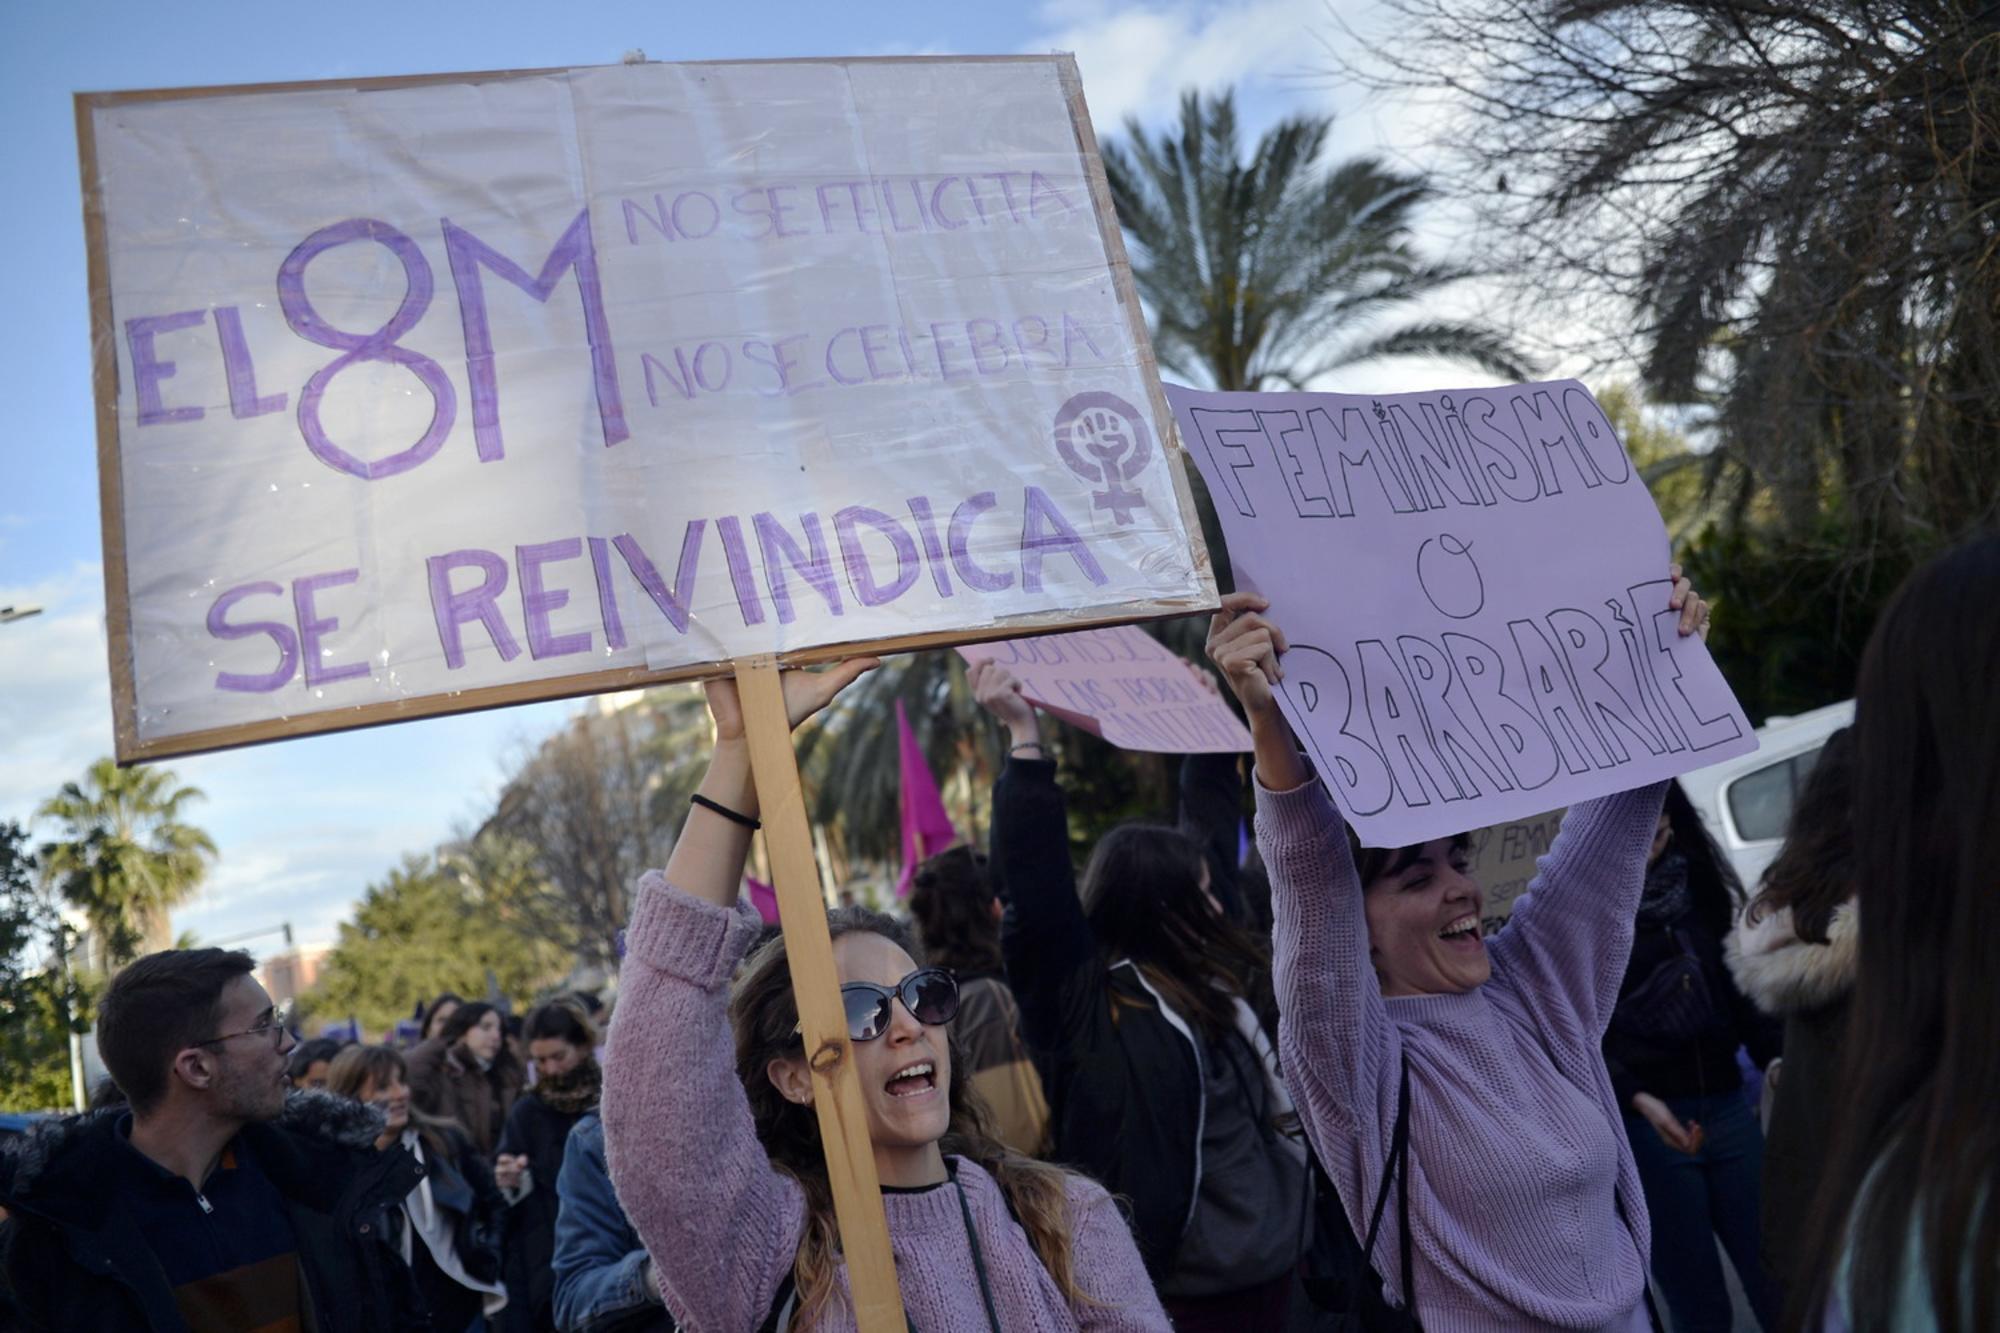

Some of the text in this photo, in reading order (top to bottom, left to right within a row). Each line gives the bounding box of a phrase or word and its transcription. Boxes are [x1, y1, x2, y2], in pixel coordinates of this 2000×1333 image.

[621, 170, 1079, 245] NO SE FELICITA
[124, 207, 630, 481] EL 8M
[640, 312, 1104, 407] NO SE CELEBRA
[205, 485, 1110, 693] SE REIVINDICA
[1416, 533, 1485, 619] O
